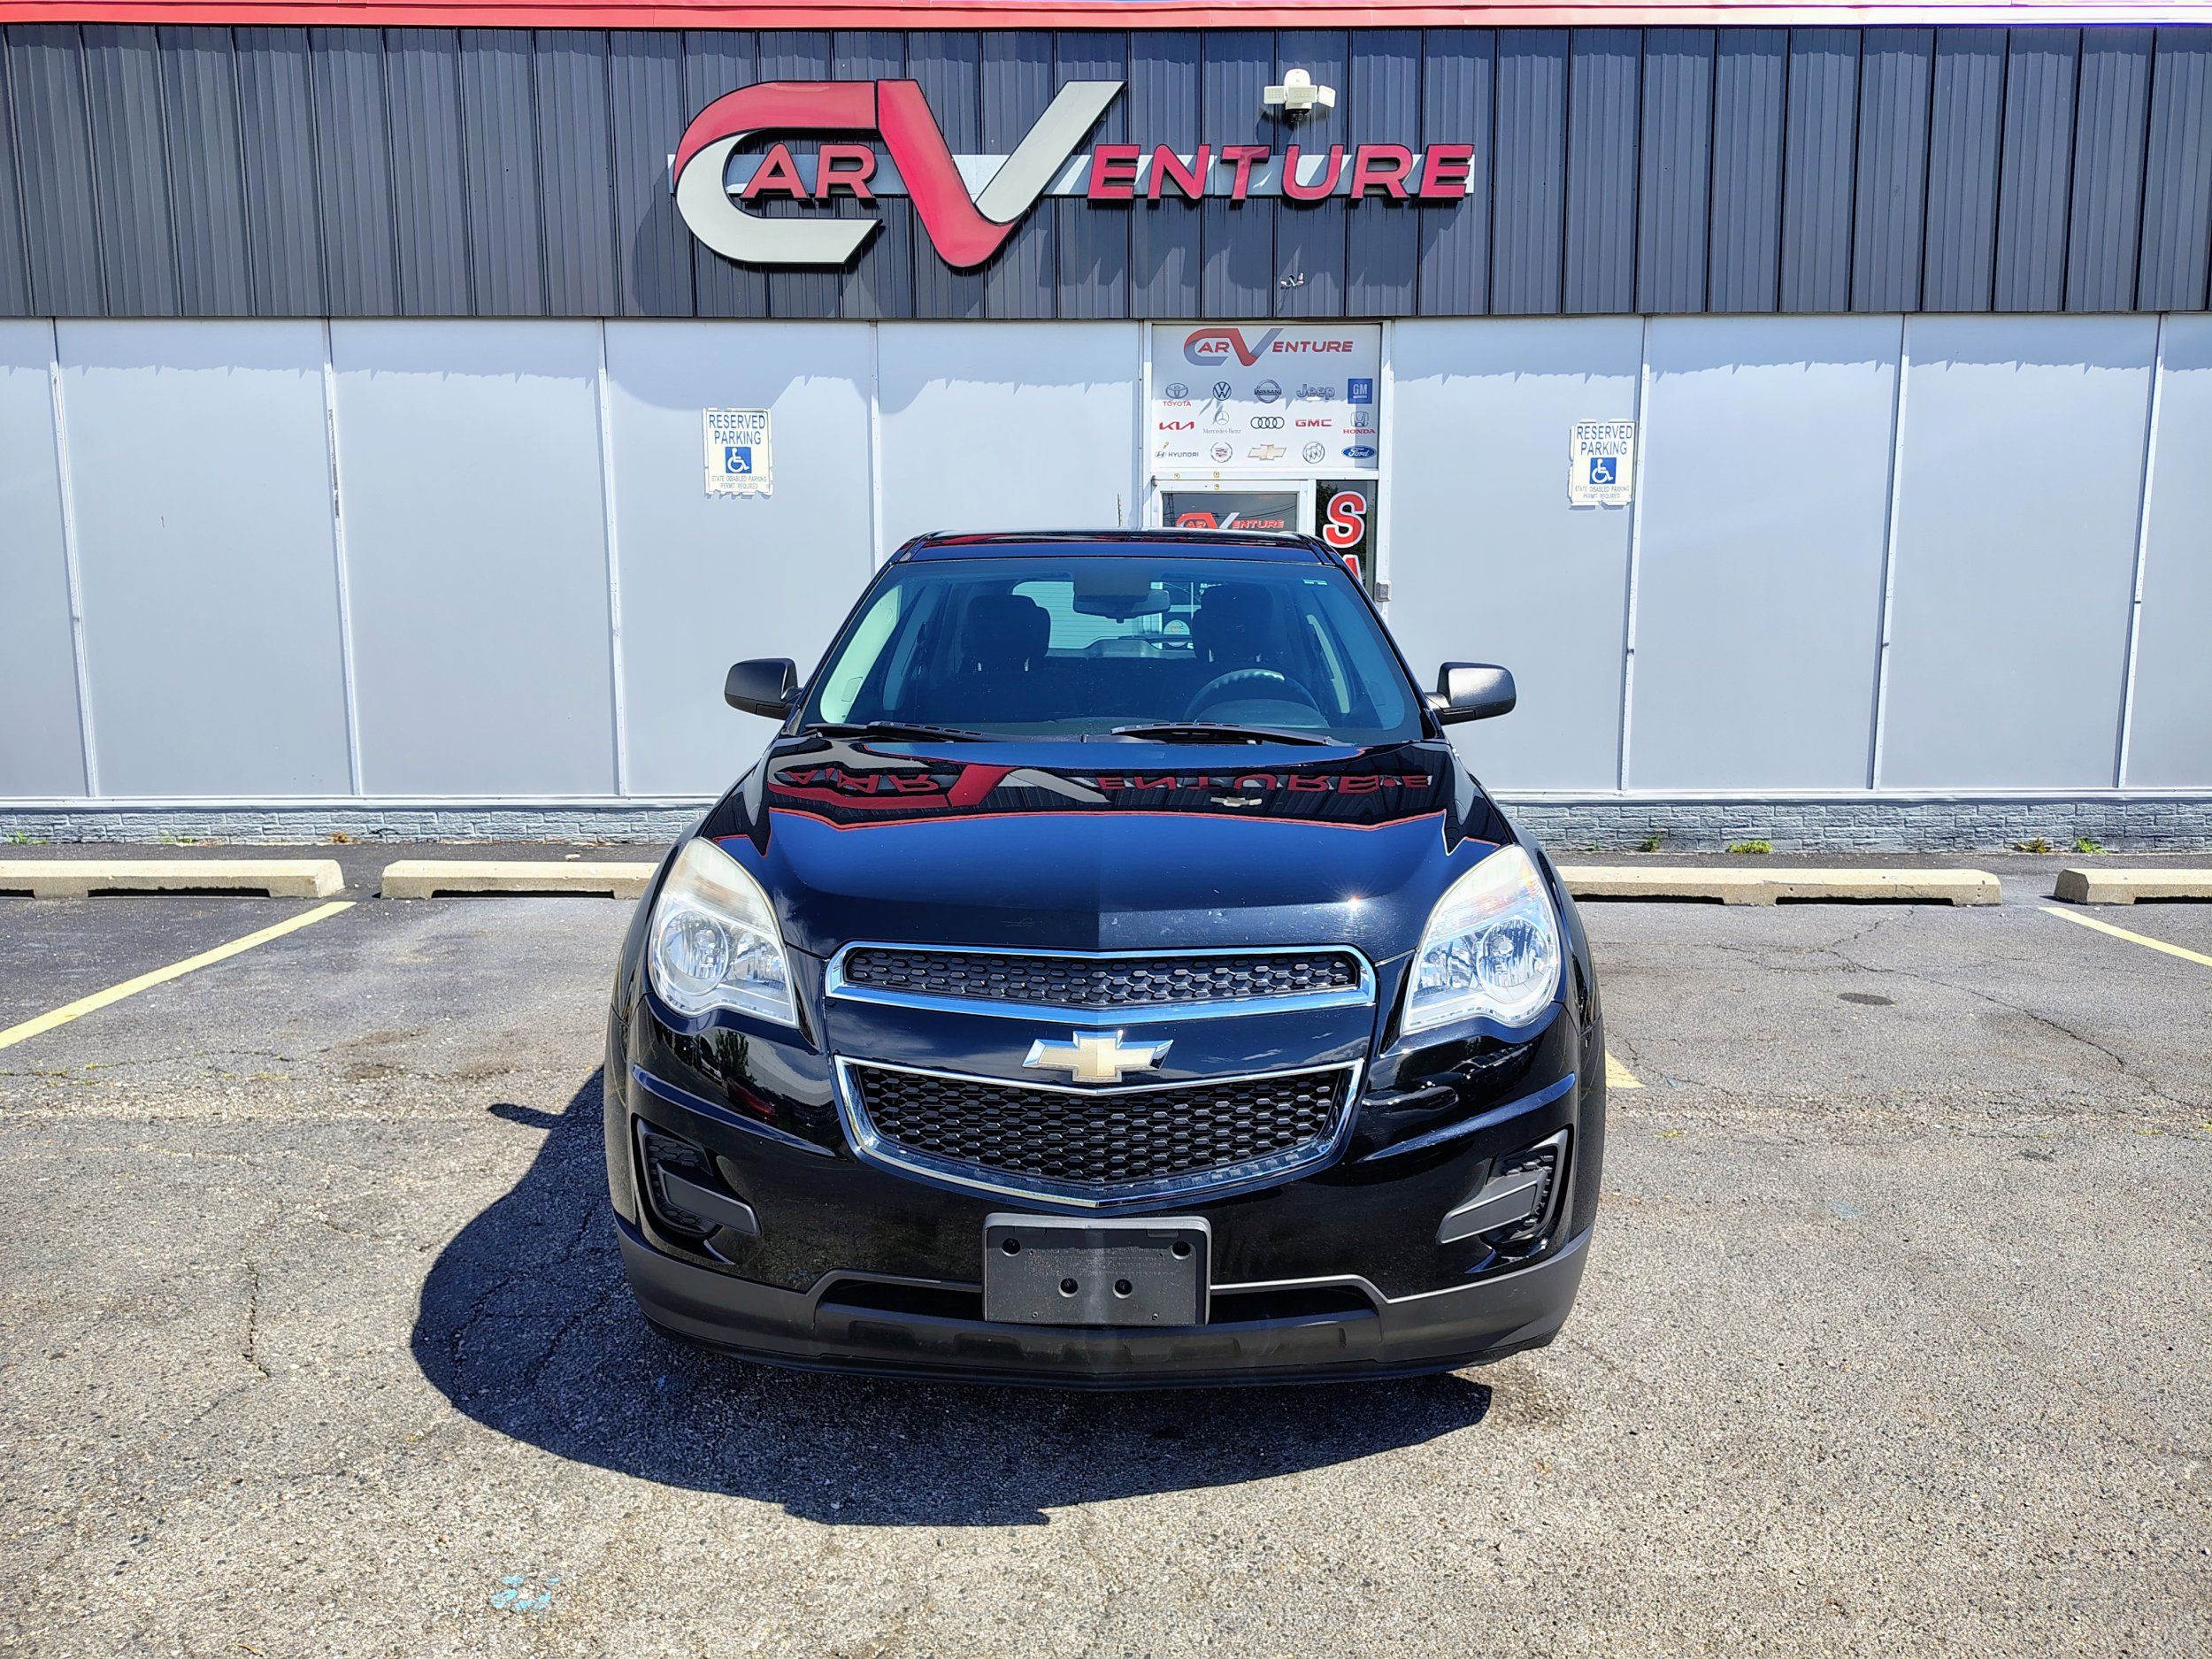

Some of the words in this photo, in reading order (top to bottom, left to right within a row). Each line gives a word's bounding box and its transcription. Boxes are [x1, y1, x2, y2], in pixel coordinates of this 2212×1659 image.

[1296, 383, 1336, 400] Jeep
[709, 414, 766, 429] RESERVED
[1159, 421, 1194, 430] KIA
[1294, 419, 1332, 427] GMC
[714, 430, 762, 445] PARKING
[1577, 425, 1632, 440] RESERVED
[1580, 441, 1627, 456] PARKING
